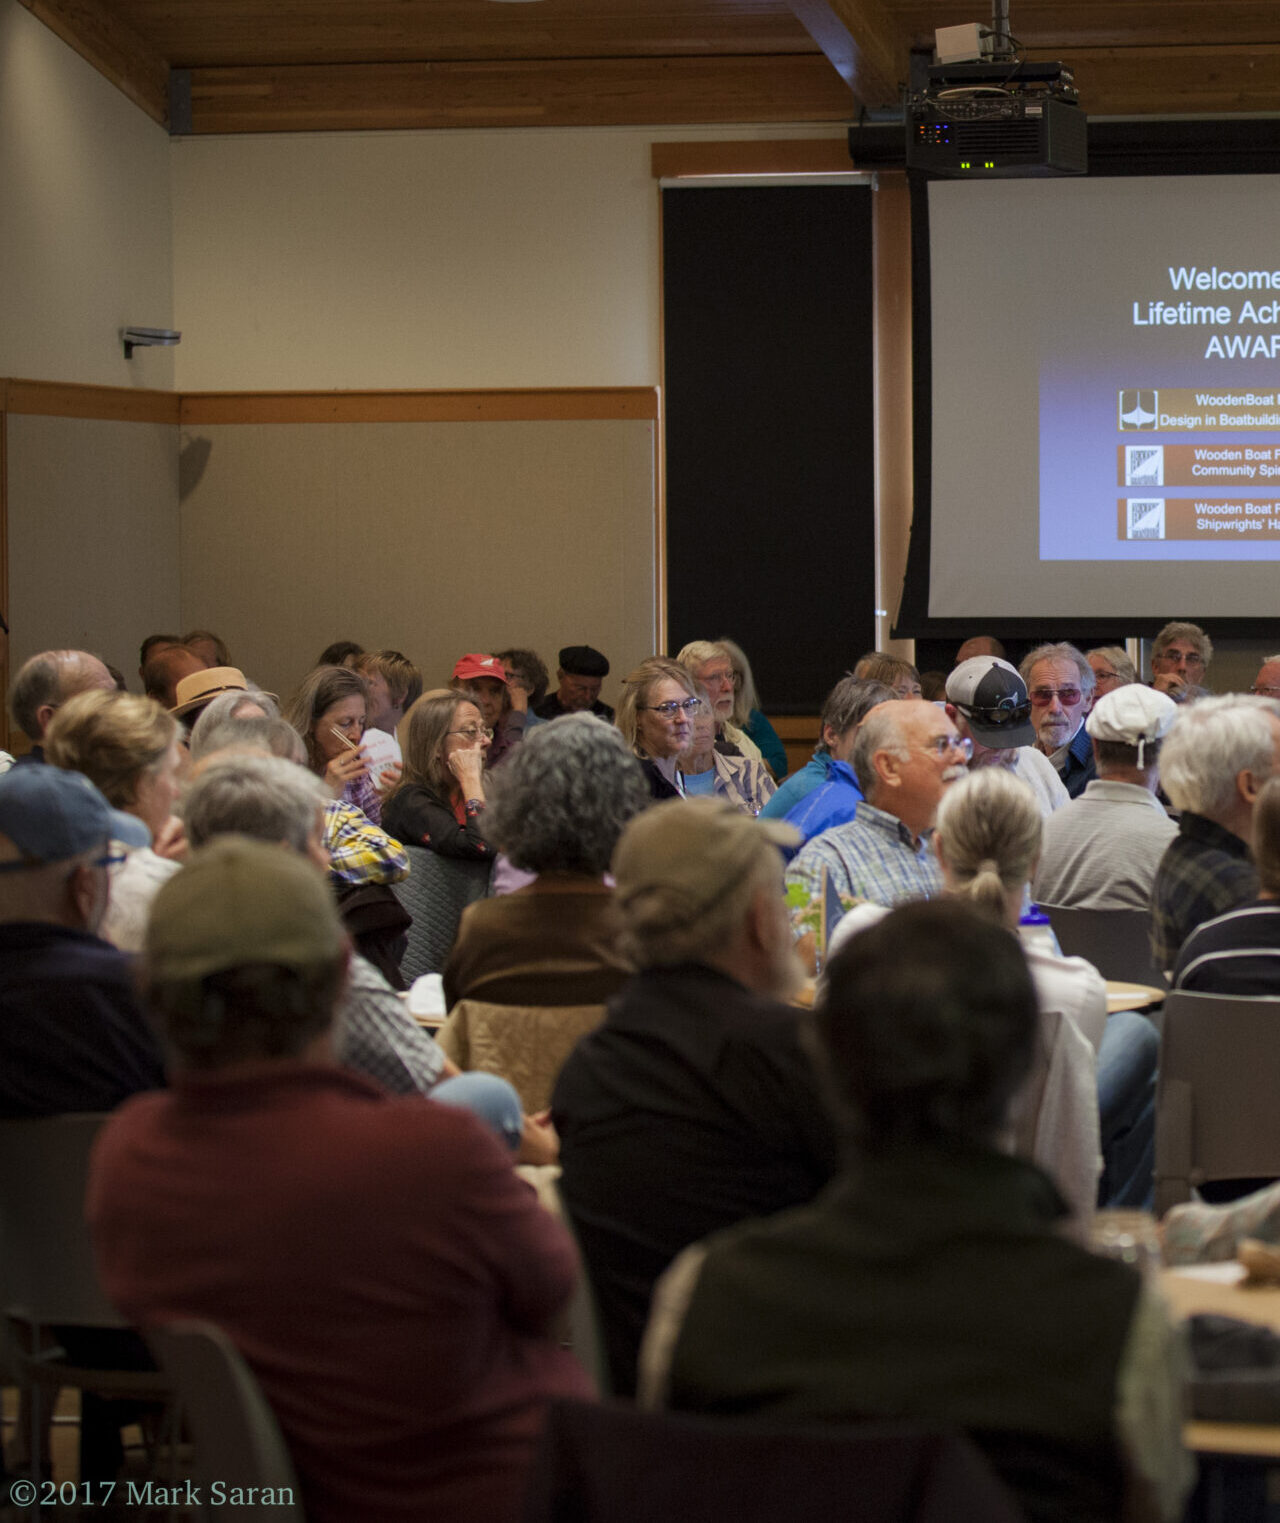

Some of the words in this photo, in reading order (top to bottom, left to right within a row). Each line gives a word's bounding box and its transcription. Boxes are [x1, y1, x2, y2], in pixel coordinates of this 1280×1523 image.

[1133, 301, 1231, 326] Lifetime
[1195, 393, 1274, 406] WoodenBoat
[1160, 413, 1201, 428] Design
[1205, 413, 1216, 426] in
[1194, 448, 1242, 460] Wooden
[1245, 448, 1272, 460] Boat
[1192, 464, 1256, 478] Community
[1194, 502, 1242, 515] Wooden
[1245, 502, 1272, 515] Boat
[1196, 518, 1265, 532] Shipwrights'
